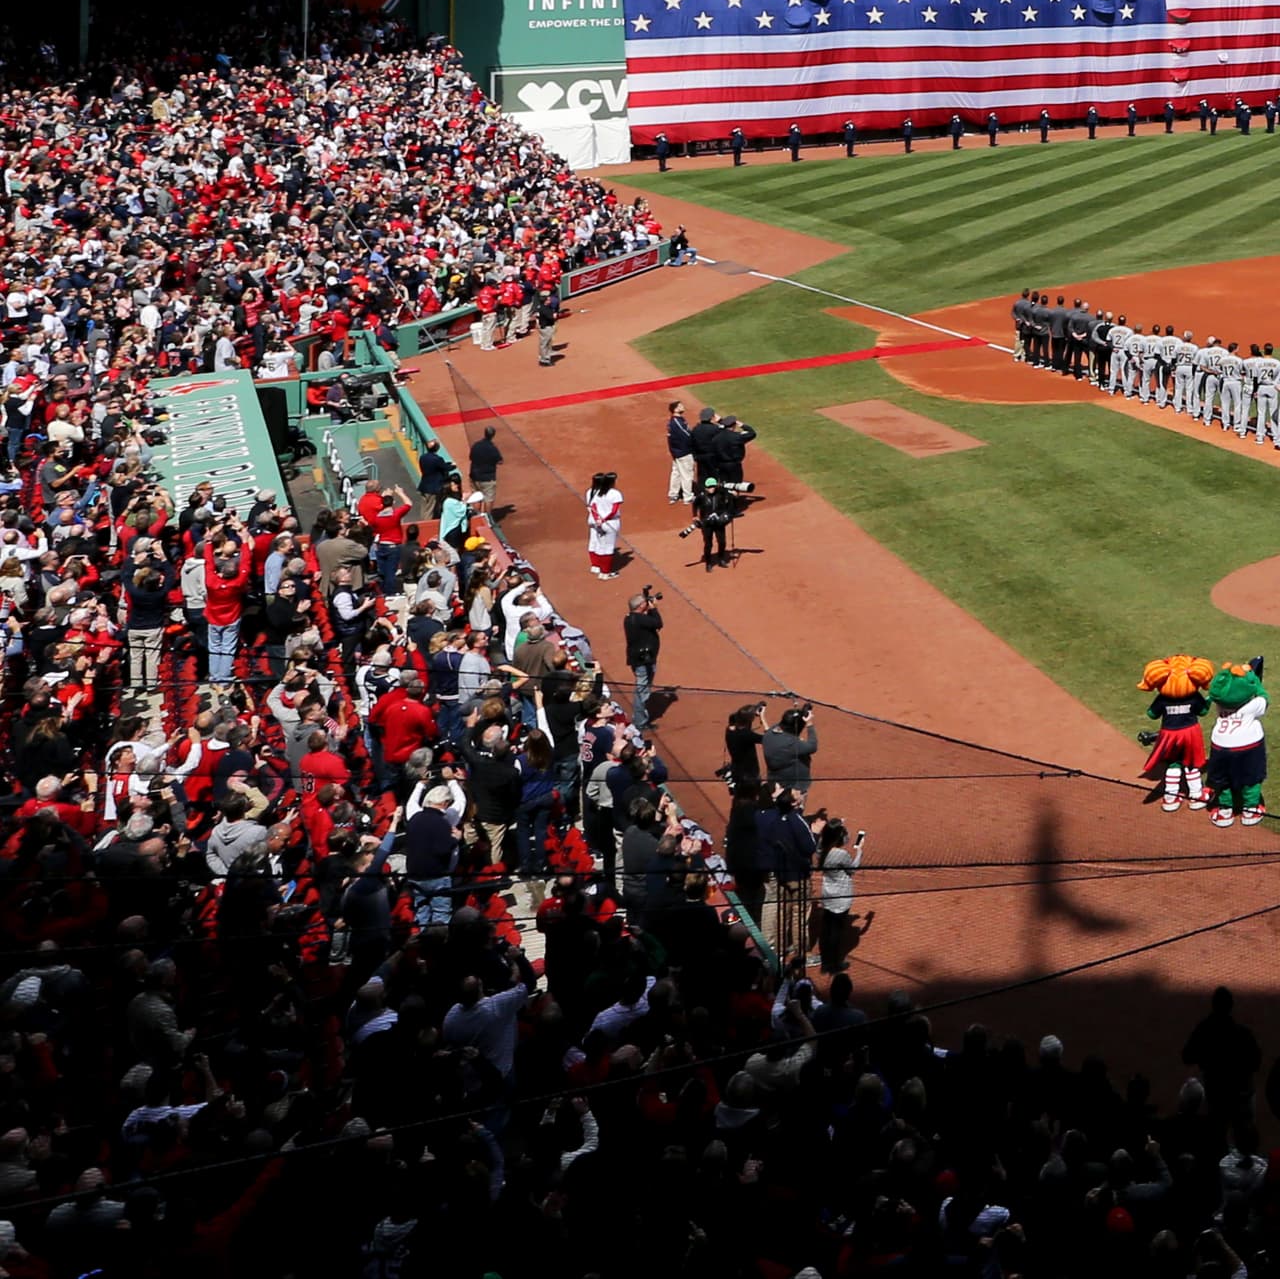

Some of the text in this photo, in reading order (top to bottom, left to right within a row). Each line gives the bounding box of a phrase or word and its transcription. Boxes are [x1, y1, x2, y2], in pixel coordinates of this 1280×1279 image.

[528, 20, 587, 29] EMPOWER
[589, 19, 611, 28] THE
[168, 394, 250, 468] FENWAY
[1218, 719, 1242, 735] 97
